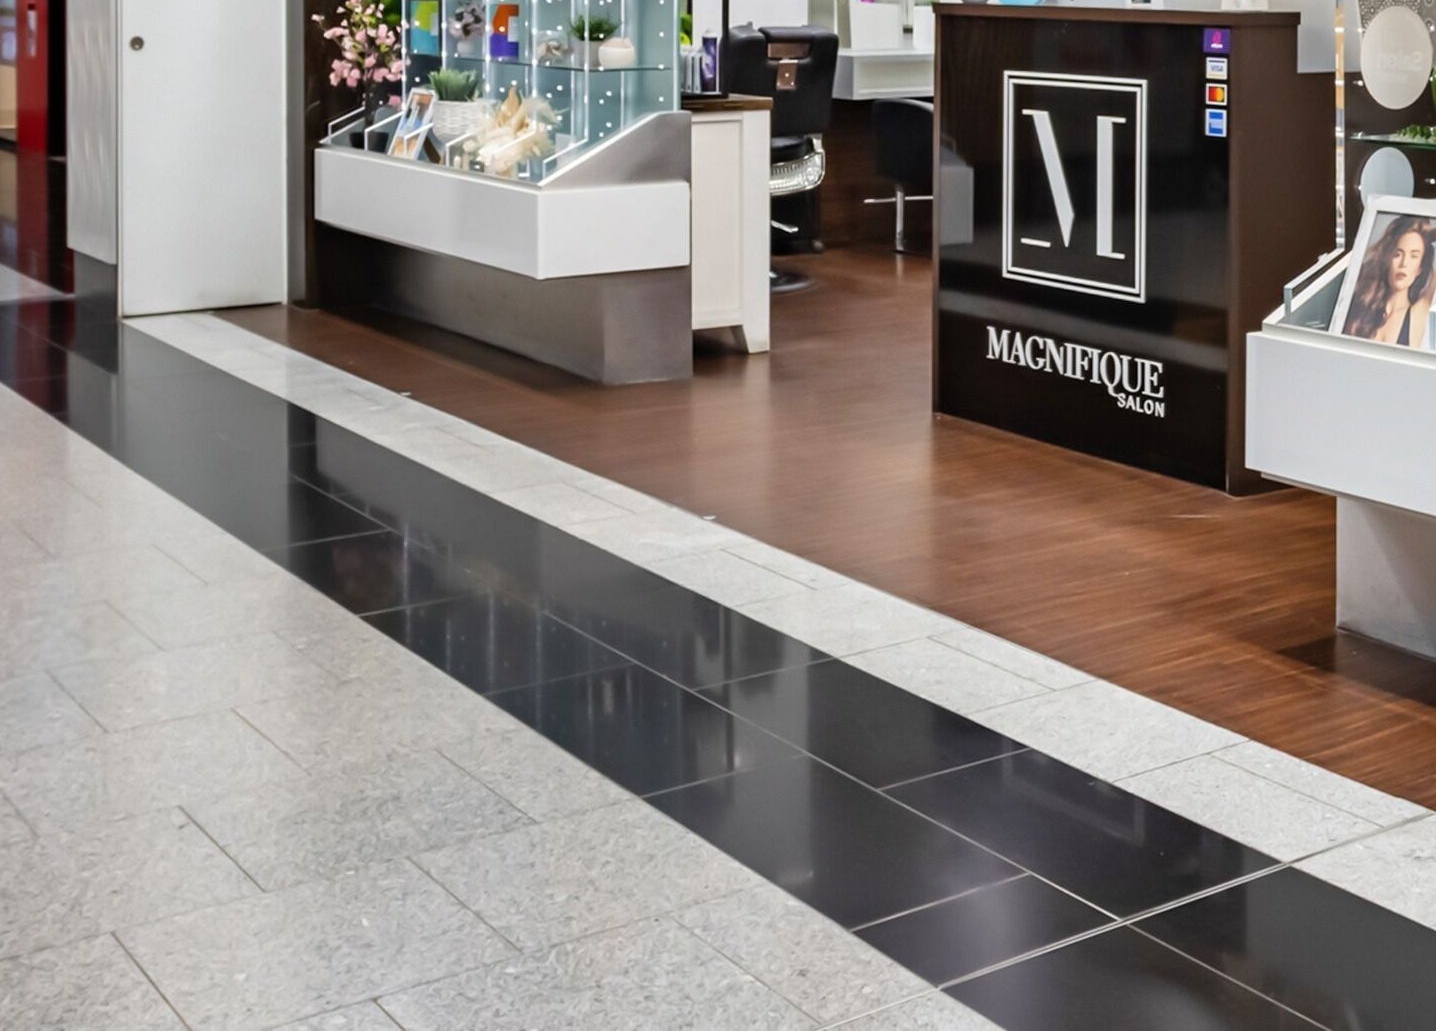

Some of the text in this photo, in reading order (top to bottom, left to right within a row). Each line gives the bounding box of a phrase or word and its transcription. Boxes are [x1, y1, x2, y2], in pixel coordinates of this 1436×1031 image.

[1020, 109, 1126, 260] M
[986, 326, 1165, 398] MAGNIFIQUE
[1117, 392, 1165, 417] SALON
